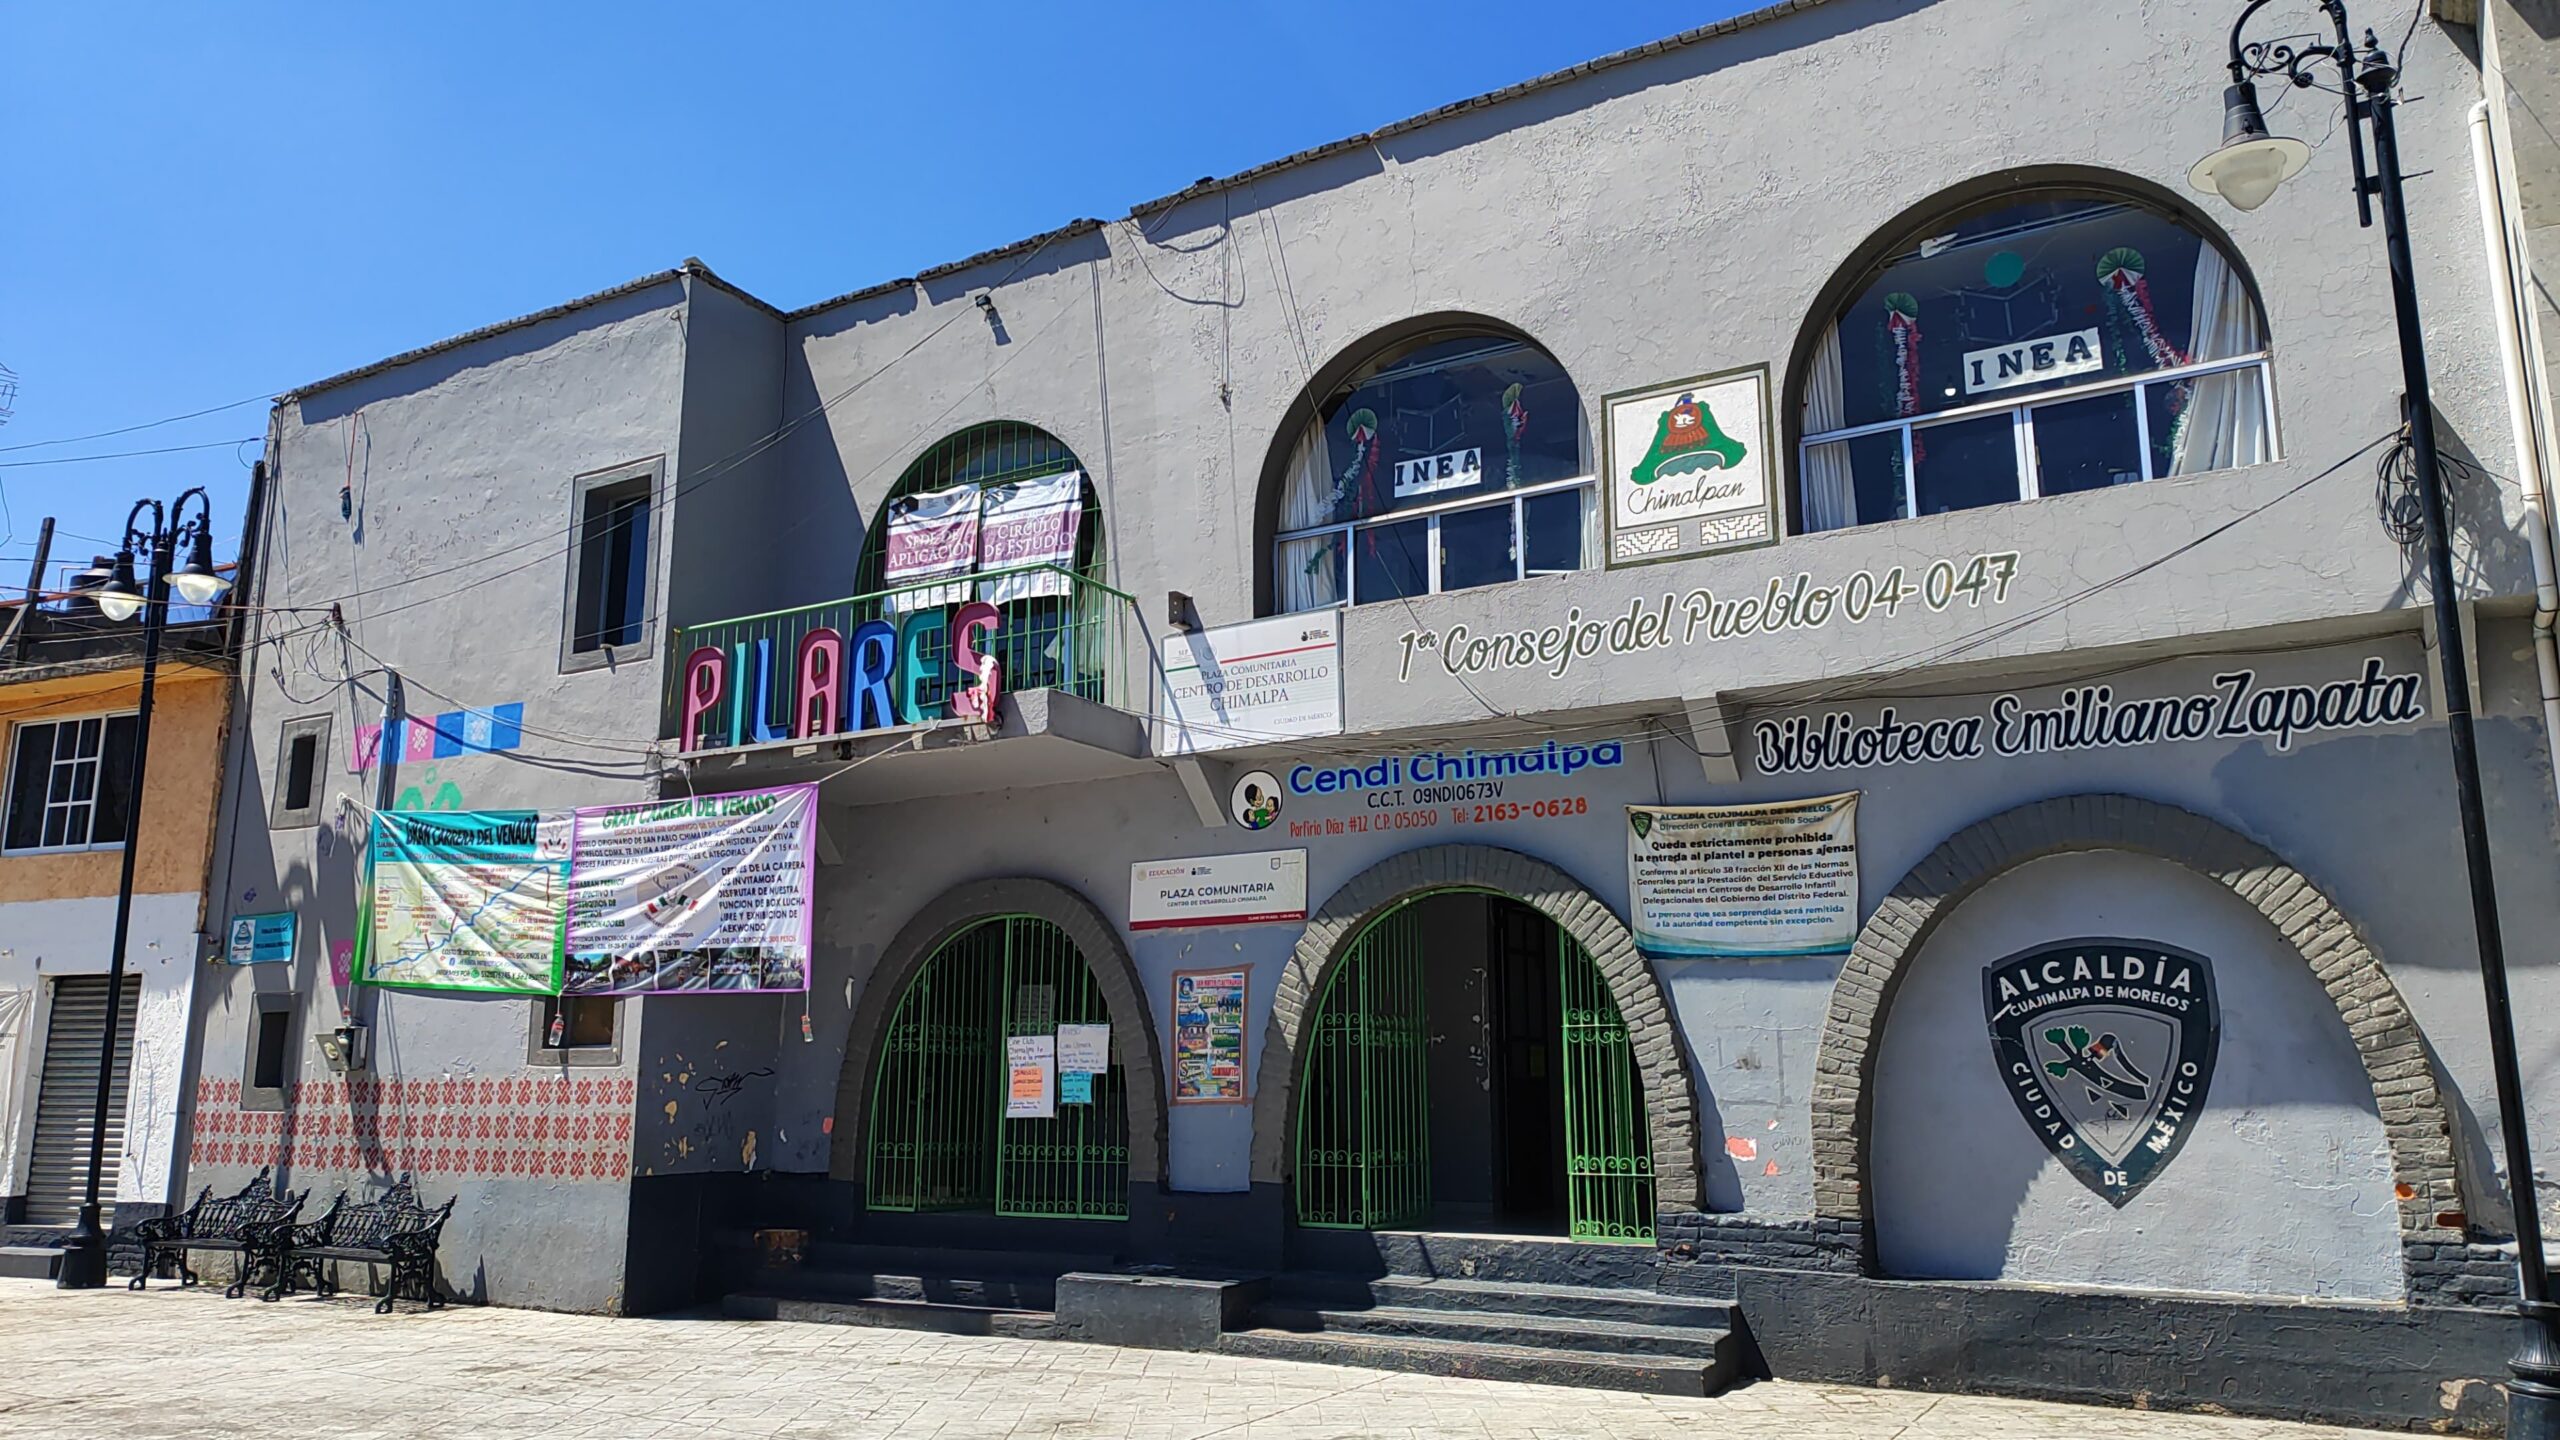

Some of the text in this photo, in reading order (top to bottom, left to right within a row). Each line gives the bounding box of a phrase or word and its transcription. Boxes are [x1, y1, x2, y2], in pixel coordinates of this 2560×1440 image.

[1971, 335, 2091, 387] INEA
[1395, 449, 1480, 487] INEA
[1628, 475, 1745, 515] Chimalpan
[984, 543, 1003, 558] DE
[1442, 608, 1609, 678] Consejo
[1609, 595, 1674, 653] del
[1681, 573, 1841, 644] Pueblo
[679, 602, 1000, 753] PILARES
[1201, 658, 1297, 681] PLAZA COMUNITARIA
[1173, 666, 1328, 700] CENTRO DE DESARROLLO
[1210, 688, 1289, 712] CHIMALPA
[1753, 657, 2424, 776] Biblioteca Emiliano Zapata
[1290, 739, 1624, 794] Cendi Chimalpa
[1367, 790, 1405, 808] C.C.T.
[602, 808, 638, 829] GRAN
[697, 796, 717, 817] DEL
[721, 793, 778, 816] VENADO
[1290, 818, 1322, 837] Porfirio
[1326, 817, 1344, 835] Díaz
[1374, 813, 1391, 831] C.P.
[1395, 809, 1438, 829] 05050
[1452, 807, 1469, 826] Tel:
[1474, 797, 1588, 824] 2163-0628
[1660, 805, 1833, 821] ALCALDÍA CUAJIMALPA DE MORELOS
[405, 817, 432, 847] GRAN
[432, 825, 475, 847] CARRERA
[477, 828, 494, 845] DEL
[495, 815, 539, 845] VENADO
[1660, 815, 1825, 831] Dirección General de Desarrollo Social
[575, 840, 597, 849] PUEBLO
[634, 836, 642, 845] DE
[643, 835, 656, 844] SAN
[657, 834, 678, 844] PABLO
[790, 820, 799, 829] DE
[726, 837, 756, 846] HISTORIA
[1651, 832, 1834, 851] Queda estrictamente prohibida
[1634, 854, 1644, 862] la
[1645, 852, 1687, 863] entrada
[1690, 852, 1701, 861] al
[1704, 850, 1745, 862] plantel
[1758, 847, 1813, 860] personas
[1816, 844, 1854, 856] ajenas
[749, 861, 806, 873] DE LA CARRERA
[1148, 867, 1185, 877] EDUCACIÓN
[1640, 867, 1678, 876] Conforme
[1679, 867, 1687, 875] al
[1722, 866, 1734, 874] 38
[1735, 864, 1771, 873] fracción
[1787, 863, 1799, 871] de
[1814, 861, 1850, 869] Normas
[732, 874, 783, 885] INVITAMOS A
[1677, 878, 1695, 886] para
[1697, 876, 1705, 884] la
[1706, 875, 1752, 884] Prestación
[1756, 874, 1770, 882] del
[1772, 872, 1807, 881] Servicio
[1809, 869, 1854, 879] Educativo
[718, 885, 799, 898] DISFRUTAR DE NUESTRA
[1160, 882, 1275, 900] PLAZA COMUNITARIA
[1652, 886, 1695, 895] Asistencial
[1709, 886, 1743, 894] Centros
[1744, 884, 1756, 892] de
[1758, 882, 1802, 892] Desarrollo
[1804, 880, 1836, 889] Infantil
[755, 899, 764, 908] DE
[766, 899, 781, 907] BOX
[783, 898, 806, 906] LUCHA
[1199, 897, 1236, 905] DESARROLLO
[1237, 895, 1267, 903] CHIMALPA
[1643, 890, 1849, 905] Delegacionales del Gobierno del Distrito Federal.
[720, 912, 737, 922] LIBRE
[788, 909, 798, 918] DE
[1658, 911, 1691, 919] persona
[1693, 911, 1710, 919] que
[1805, 904, 1845, 914] remitida
[720, 923, 766, 933] TAEKWONDO
[1672, 919, 1714, 928] autoridad
[1715, 918, 1768, 928] competente
[1770, 917, 1784, 925] sin
[1998, 955, 2191, 1002] ALCALDÍA
[2008, 985, 2190, 1017] CUAJIMALPA DE MORELOS
[2012, 1061, 2076, 1150] CIUDAD
[2146, 1061, 2198, 1154] MÉXICO
[2103, 1171, 2128, 1187] DE
